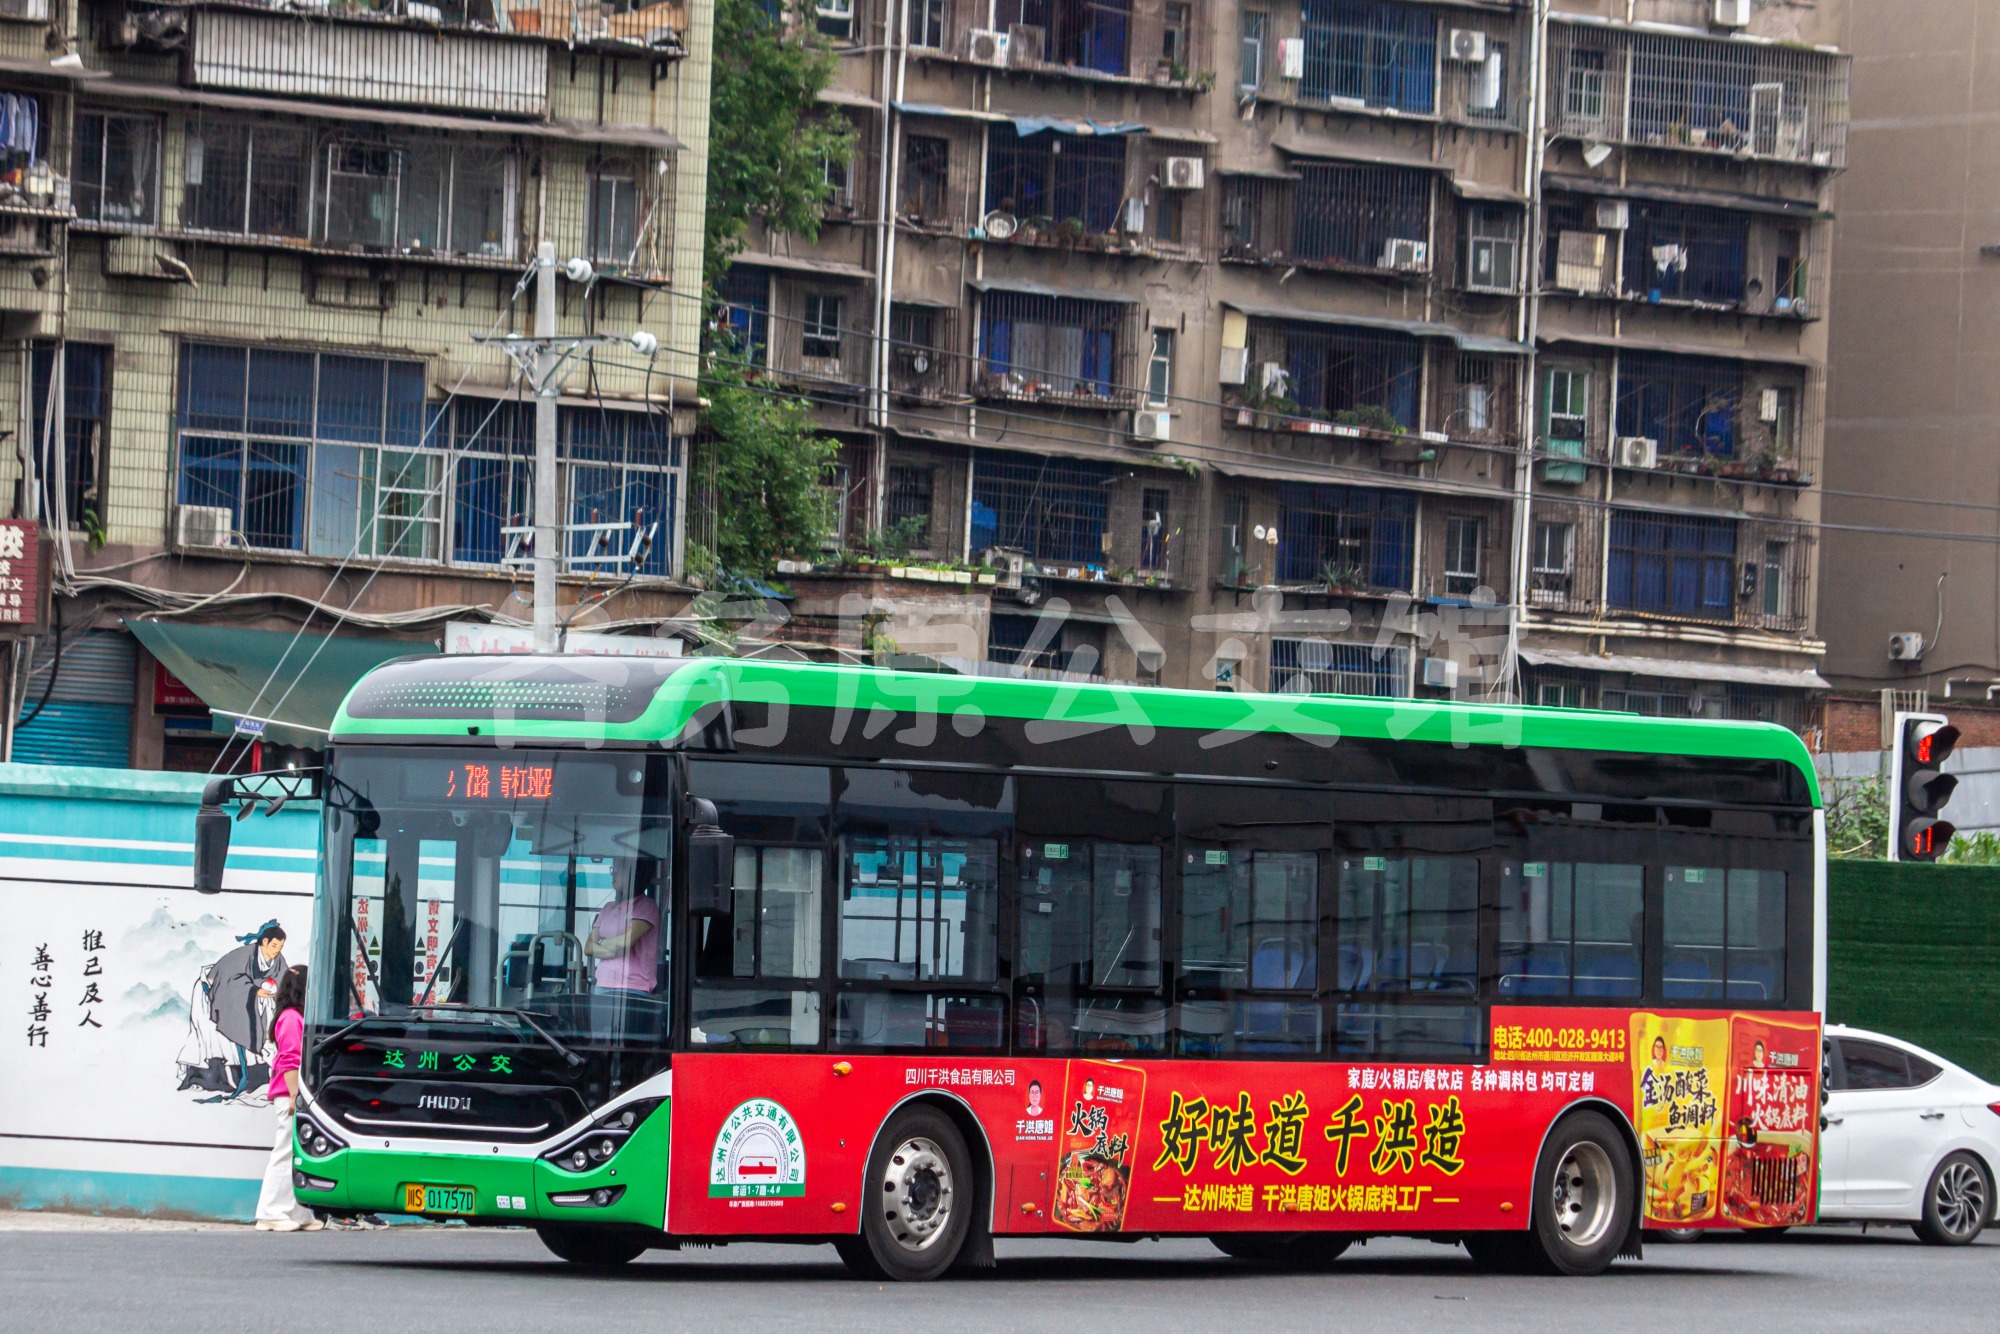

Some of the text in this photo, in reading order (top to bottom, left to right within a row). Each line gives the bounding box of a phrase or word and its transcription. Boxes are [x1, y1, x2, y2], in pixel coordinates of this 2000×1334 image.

[27, 943, 54, 1047] 善心善行
[78, 929, 106, 1028] 推己及人
[1493, 1025, 1626, 1049] 电话:400-028-9413
[383, 1050, 513, 1074] 达州公交
[905, 1068, 1015, 1086] 四川千洪食品有限公司
[1348, 1068, 1595, 1092] 家庭/火锅店/餐饮店 各种调料包 均可定制
[1640, 1065, 1711, 1111] 金汤酸菜
[1735, 1067, 1809, 1106] 川味清油
[1015, 1119, 1054, 1135] 千洪唐姐
[1066, 1102, 1109, 1137] 火锅
[1154, 1090, 1466, 1177] 好味道 千洪造
[1665, 1098, 1717, 1134] 鱼调料
[1750, 1103, 1808, 1134] 火锅底料
[716, 1103, 800, 1182] 达州市公共交通有限公司
[1091, 1132, 1128, 1168] 底料
[1183, 1184, 1432, 1212] 达州味道 千洪唐姐火锅底料工厂
